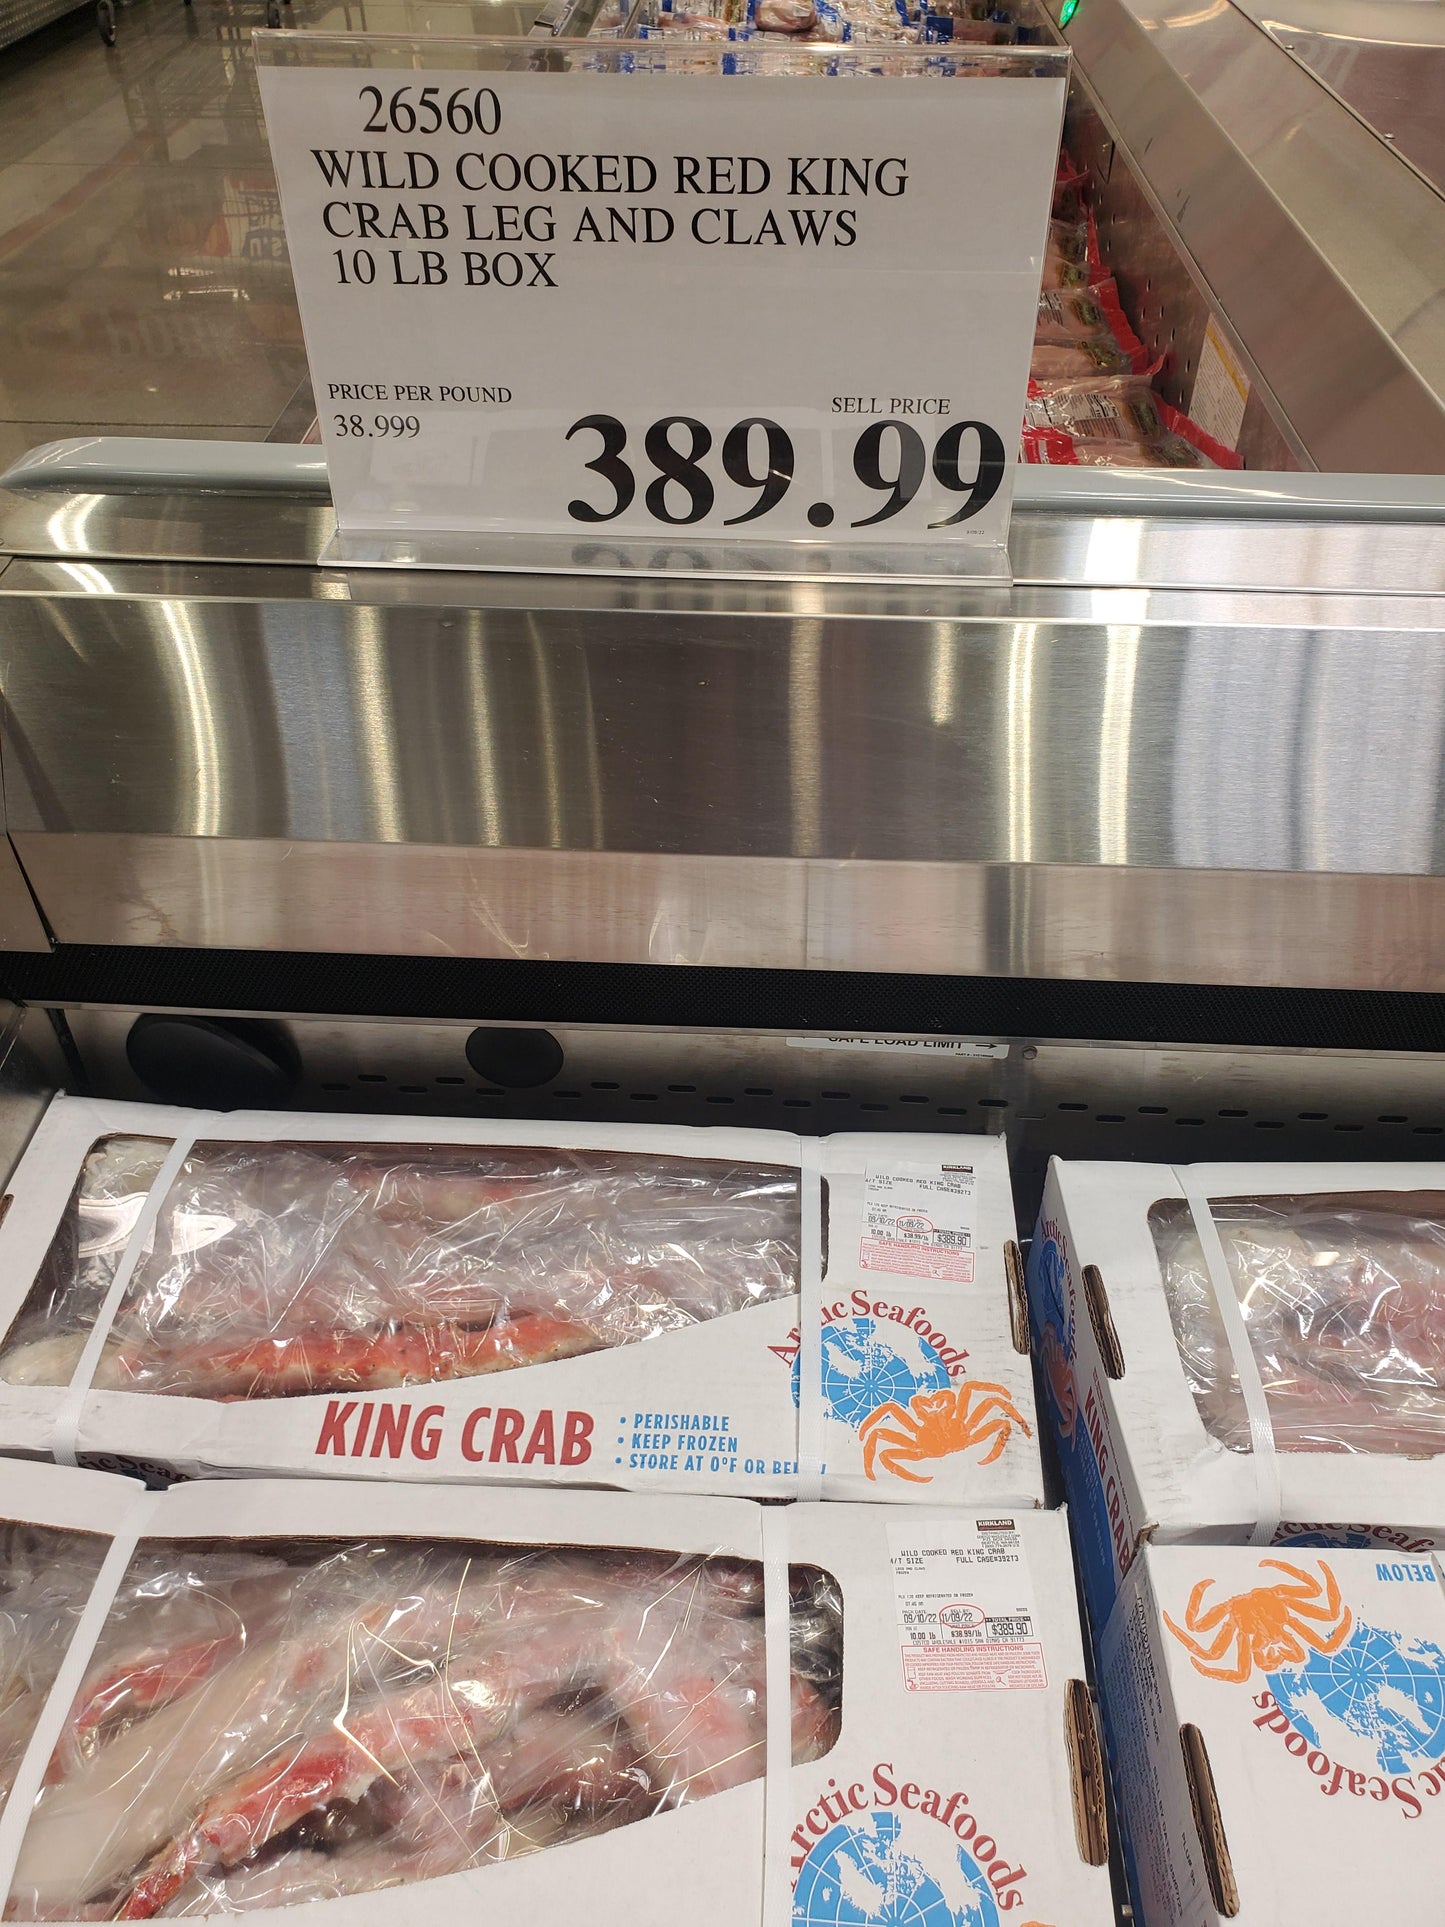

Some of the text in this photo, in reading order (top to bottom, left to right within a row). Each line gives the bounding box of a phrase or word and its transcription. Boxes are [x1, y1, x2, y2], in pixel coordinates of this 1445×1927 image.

[358, 85, 502, 136] 26560
[309, 149, 909, 197] WILD COOKED RED KING
[322, 201, 449, 240] CRAB
[462, 204, 557, 242] LEG
[572, 206, 675, 243] AND
[691, 207, 857, 247] CLAWS
[335, 249, 559, 288] 10 LB BOX
[327, 383, 512, 403] PRICE PER POUND
[831, 396, 951, 415] SELL PRICE
[333, 414, 420, 439] 38.999
[564, 413, 1006, 530] 389.99
[937, 1234, 967, 1247] $389.90
[768, 1289, 970, 1377] Aric Seafoods
[315, 1400, 594, 1466] KING CRAB
[633, 1413, 730, 1433] PERISHABLE
[631, 1433, 738, 1453] KEEP FROZEN
[629, 1453, 678, 1470] STORE
[684, 1455, 704, 1471] AT
[744, 1458, 765, 1474] OR
[772, 1461, 827, 1475] BEL
[1084, 1386, 1109, 1478] KING
[1106, 1476, 1131, 1574] CRAB
[1375, 1563, 1436, 1583] BELOW
[903, 1613, 973, 1623] 09/10/22 11/09/22
[992, 1623, 1028, 1636] $389.90
[1252, 1691, 1423, 1820] Seafoods
[873, 1762, 1028, 1911] Seafoods
